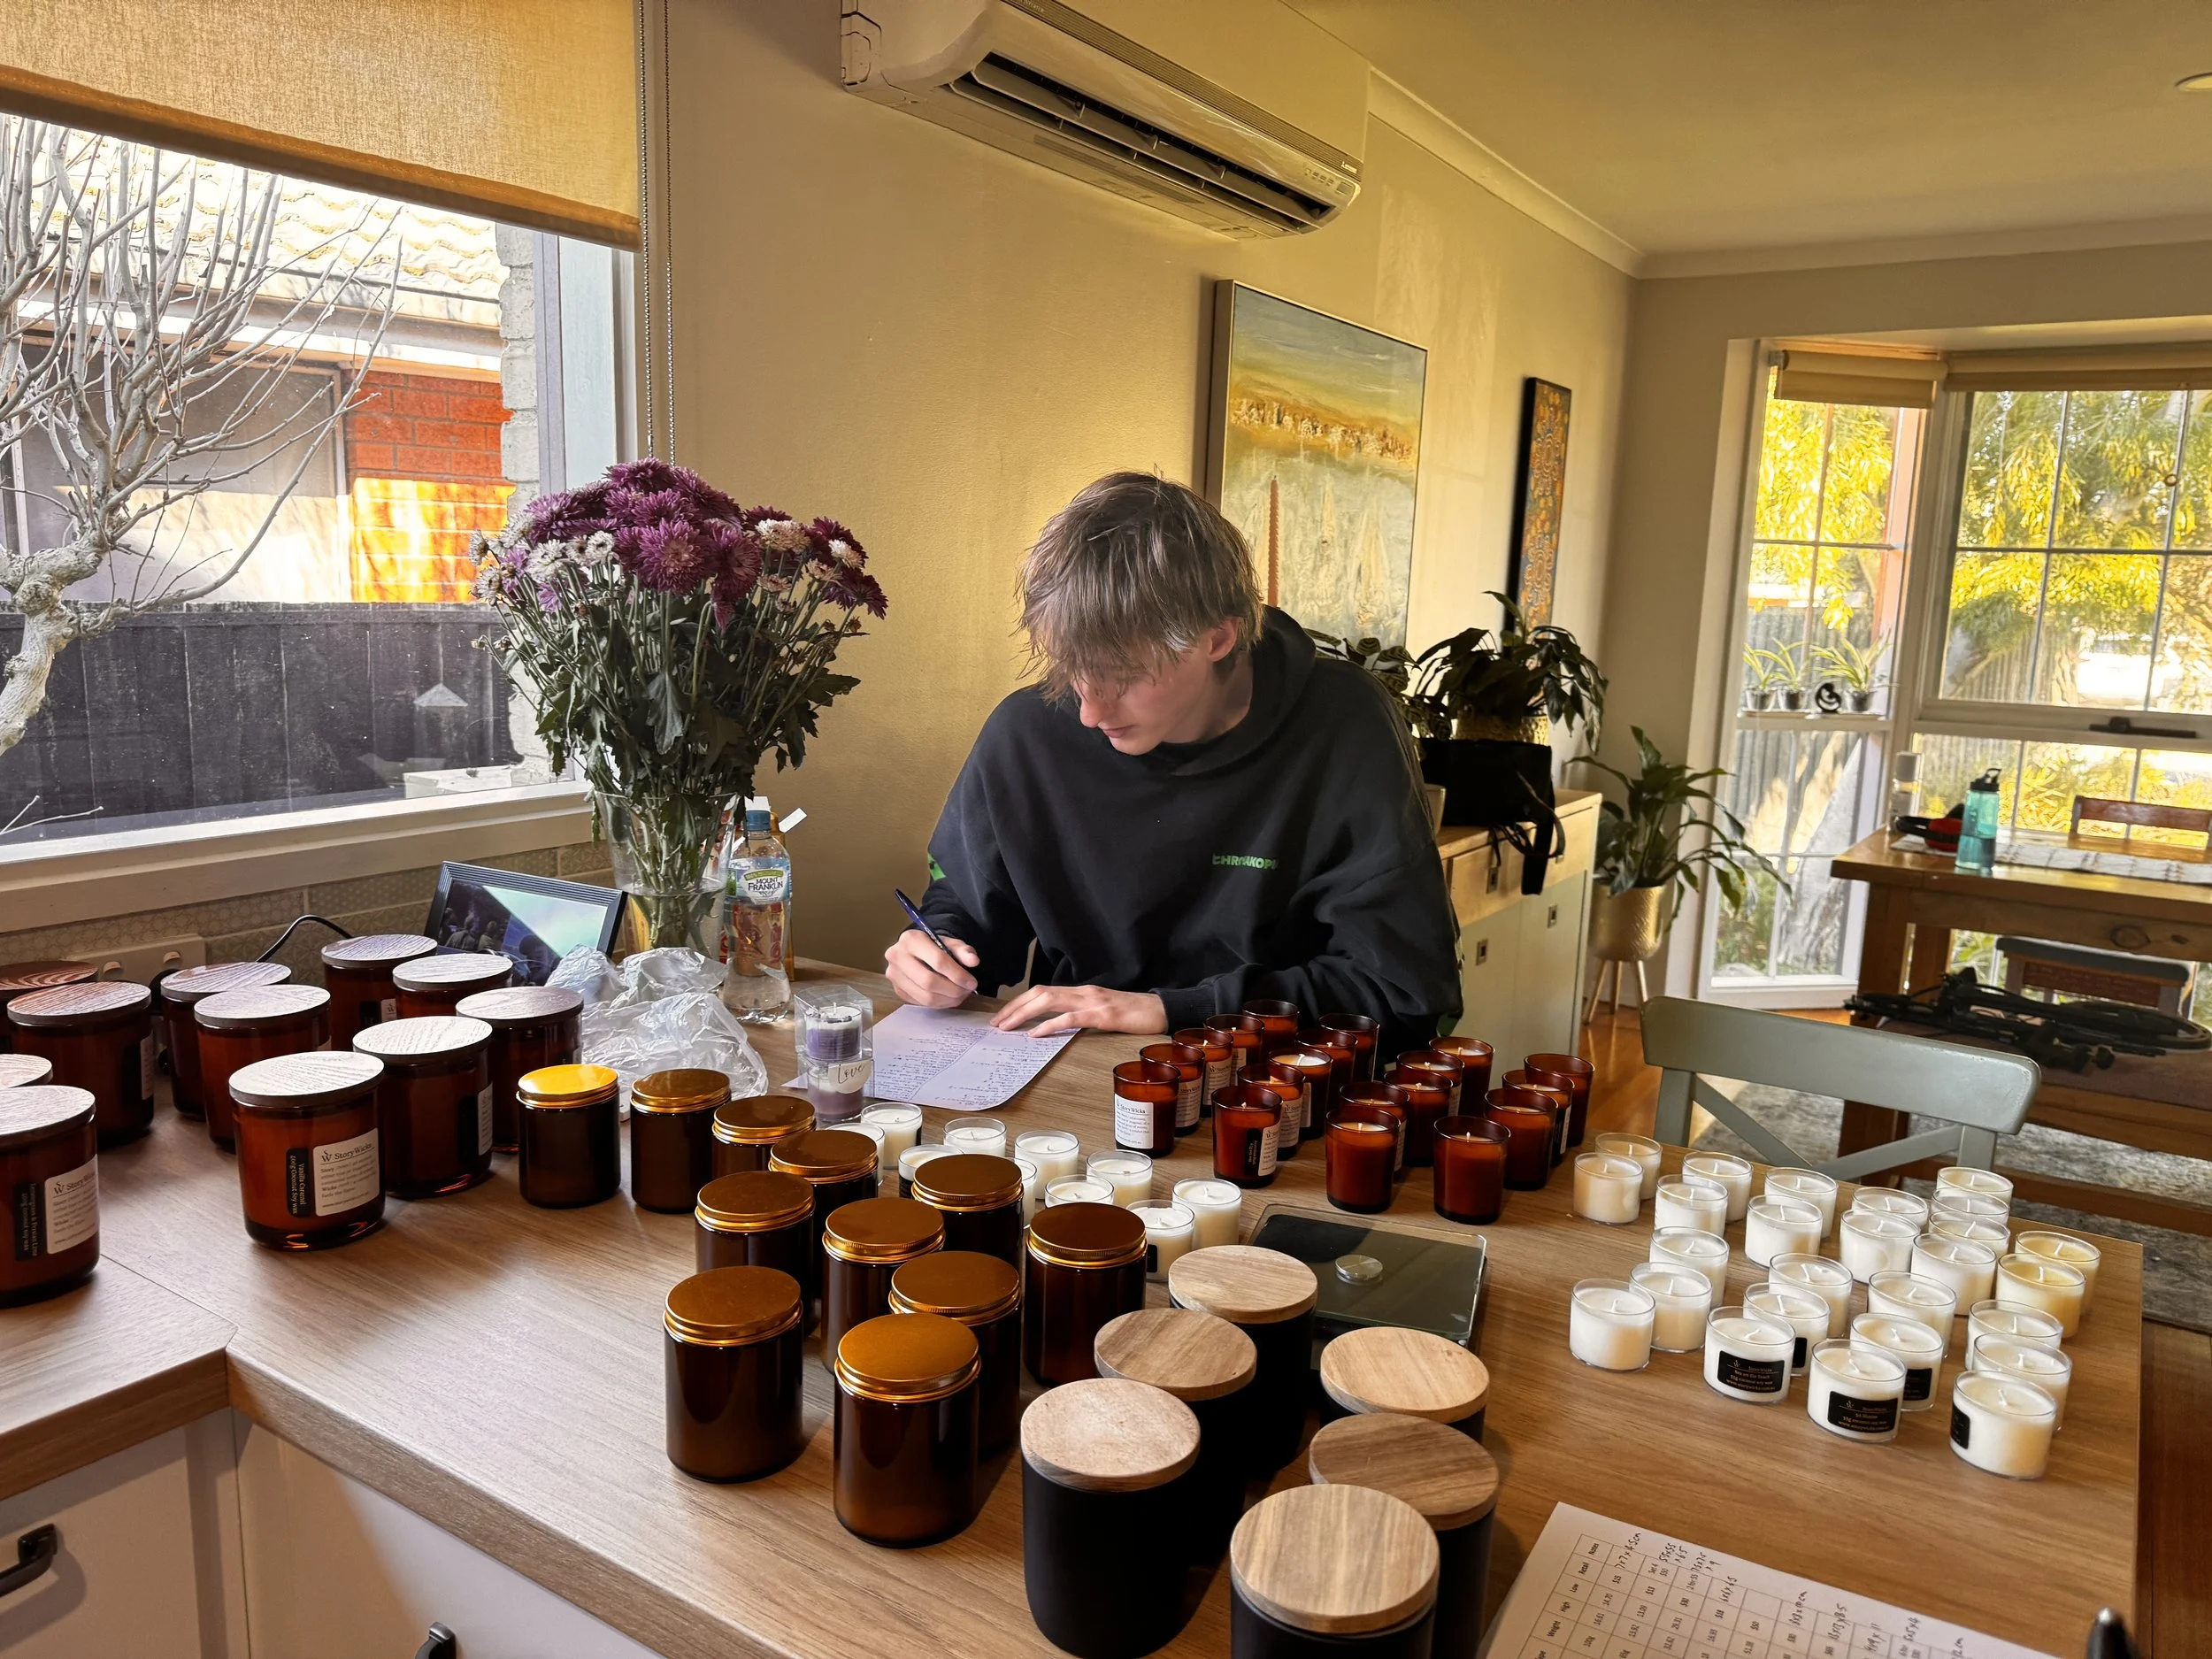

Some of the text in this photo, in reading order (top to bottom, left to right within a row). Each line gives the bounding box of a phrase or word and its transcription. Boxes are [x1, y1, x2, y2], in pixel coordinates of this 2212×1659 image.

[748, 881, 783, 891] FRANKLIN
[838, 1064, 865, 1084] Love
[1587, 1543, 1600, 1555] Notes
[1578, 1562, 1589, 1575] Retail
[1569, 1583, 1579, 1593] Low
[1560, 1601, 1571, 1613] High
[1547, 1620, 1562, 1637] Weight
